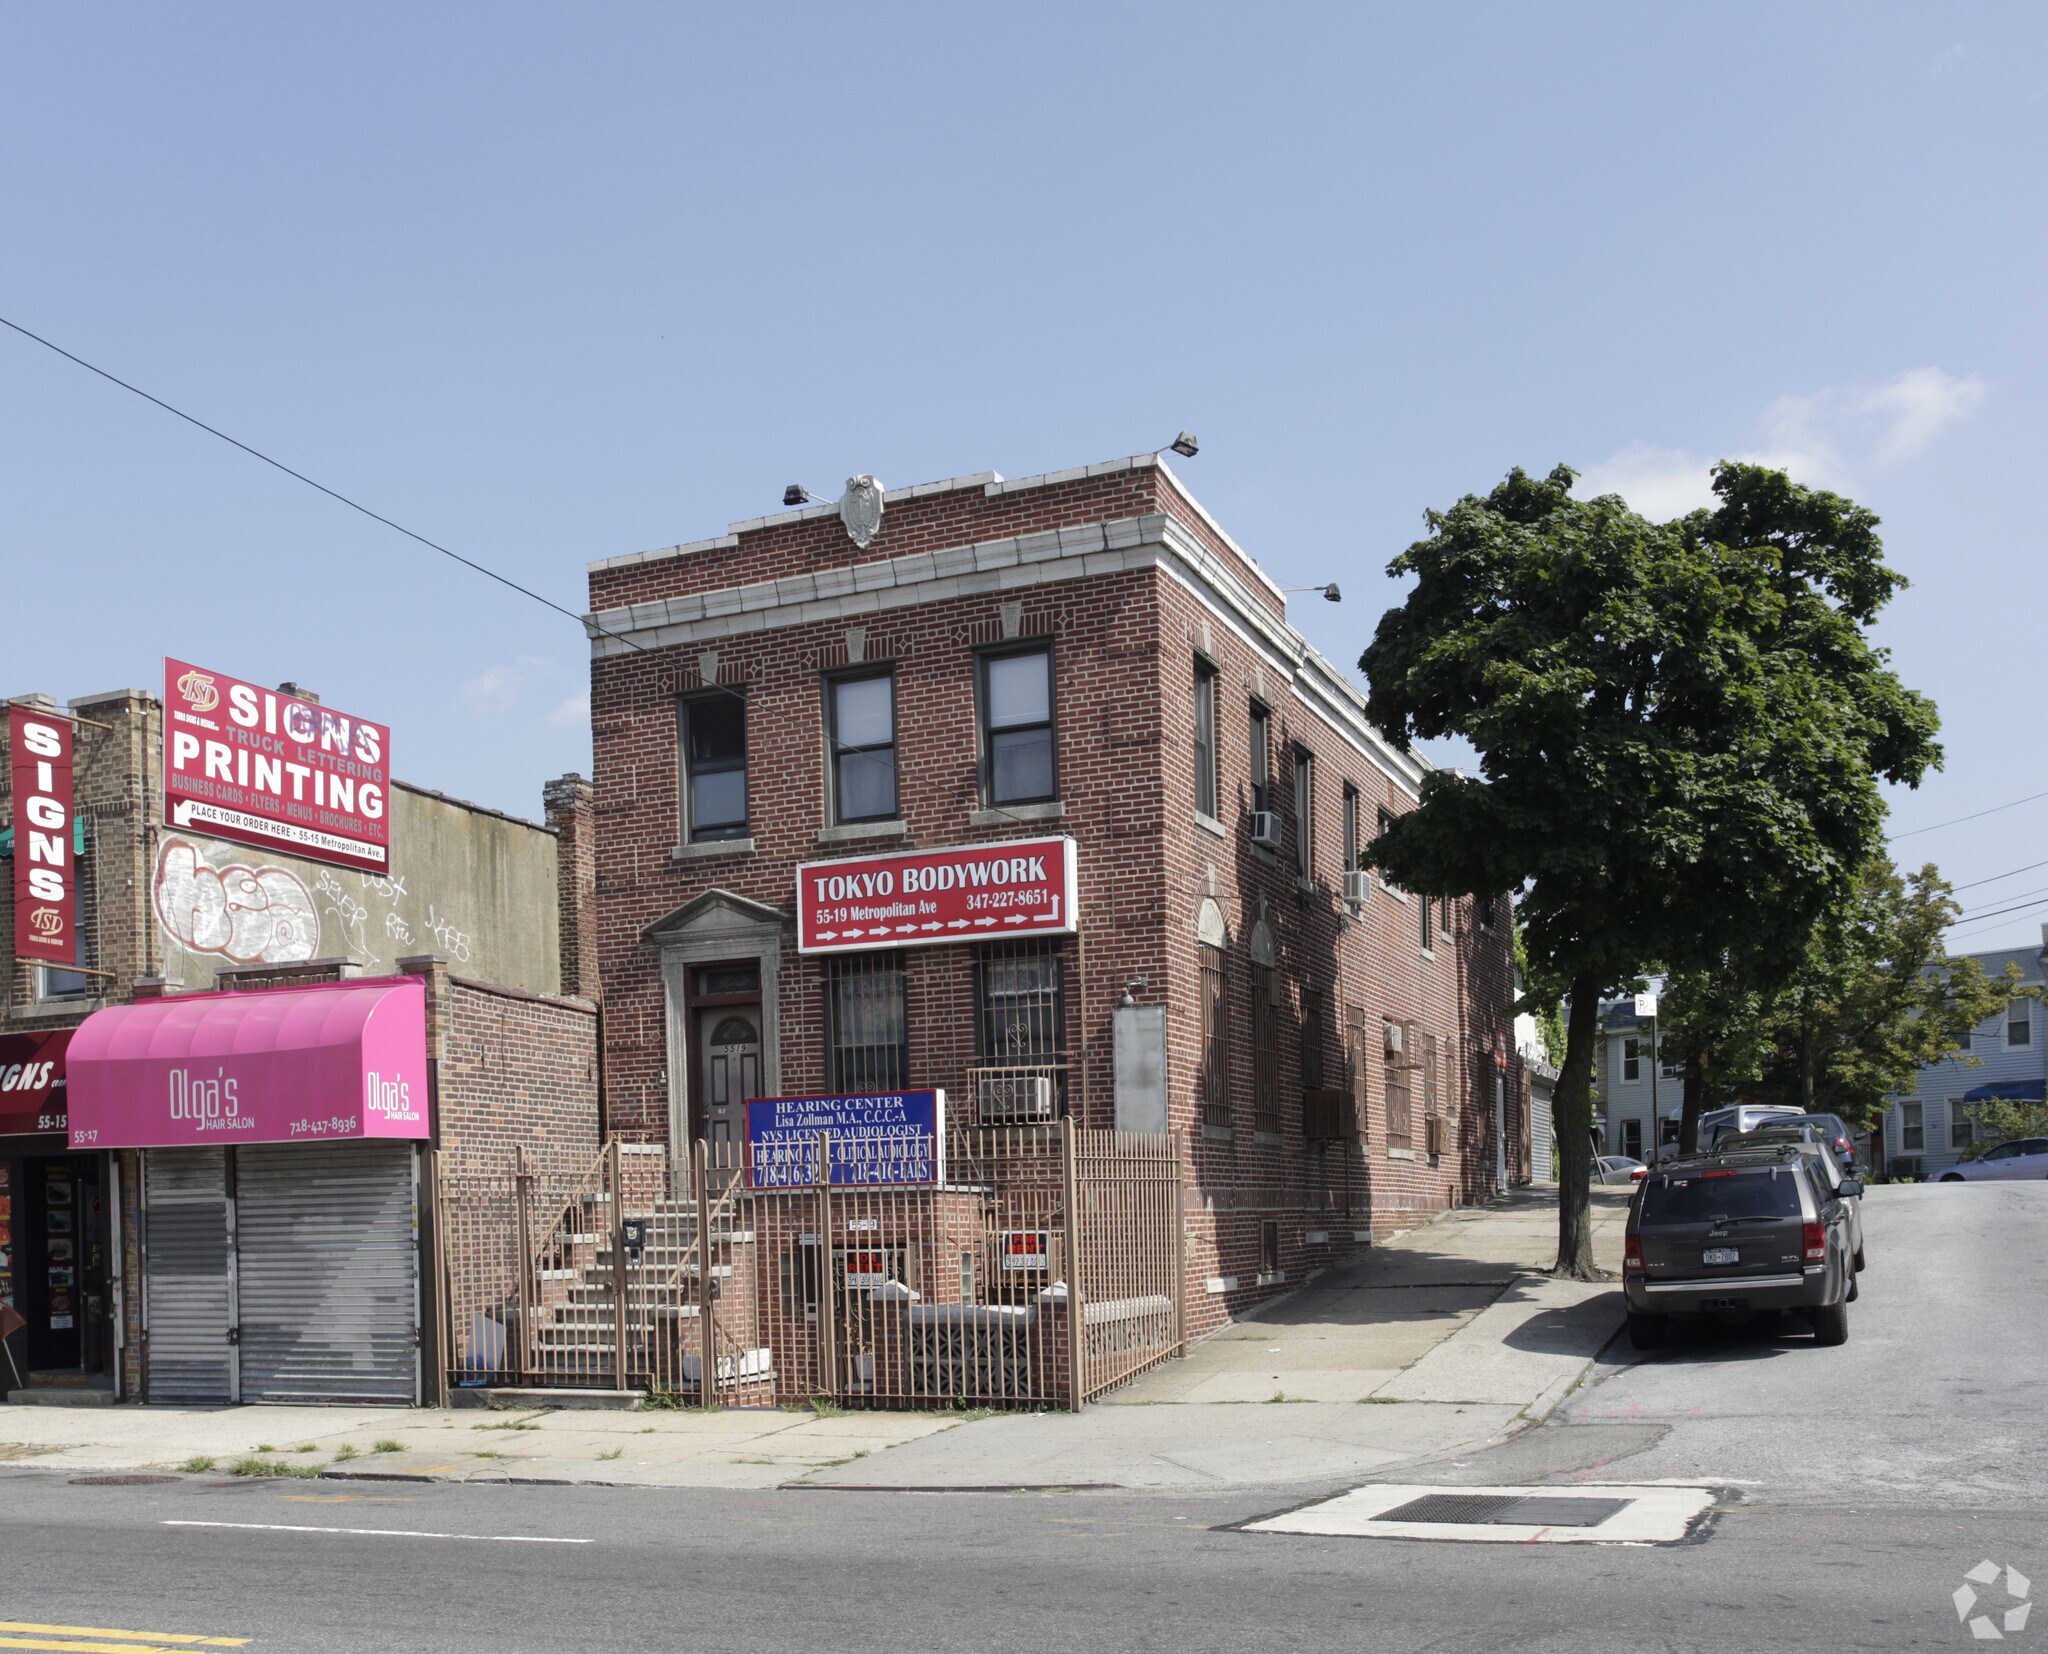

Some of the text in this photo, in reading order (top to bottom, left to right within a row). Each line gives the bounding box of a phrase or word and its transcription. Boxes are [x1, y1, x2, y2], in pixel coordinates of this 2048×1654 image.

[228, 684, 381, 764] SIGNS
[226, 725, 382, 783] TRUCK LETTERING
[173, 730, 383, 819] PRINTING
[24, 722, 65, 902] SIGNS
[172, 772, 214, 797] BUSINESS
[216, 783, 243, 804] CARDS
[250, 793, 280, 814] FLYERS
[287, 802, 313, 821] MENUS
[320, 810, 362, 833] BROCHURES
[191, 804, 382, 858] PLACE YOUR ORDER HERE 55-15 Metropolitan Ave.
[813, 855, 1047, 902] TOKYO BODYWORK
[816, 888, 1048, 924] 55-19 Metropolitan Ave 347-227-8651
[723, 1044, 747, 1053] 5519
[169, 1066, 239, 1131] Olga's
[367, 1071, 409, 1119] Olga's
[776, 1096, 904, 1113] HEARING CENTER
[38, 1115, 67, 1129] 55-15
[206, 1117, 255, 1130] HAIR SALON
[290, 1115, 357, 1136] 718-417-8936
[403, 1112, 419, 1120] SALON
[775, 1115, 794, 1127] Lisa
[796, 1111, 834, 1127] Zollman
[74, 1130, 98, 1143] 55-17
[761, 1130, 783, 1141] NYS
[843, 1124, 923, 1139] AUDIOLOGIST
[852, 1221, 875, 1229] 55-9
